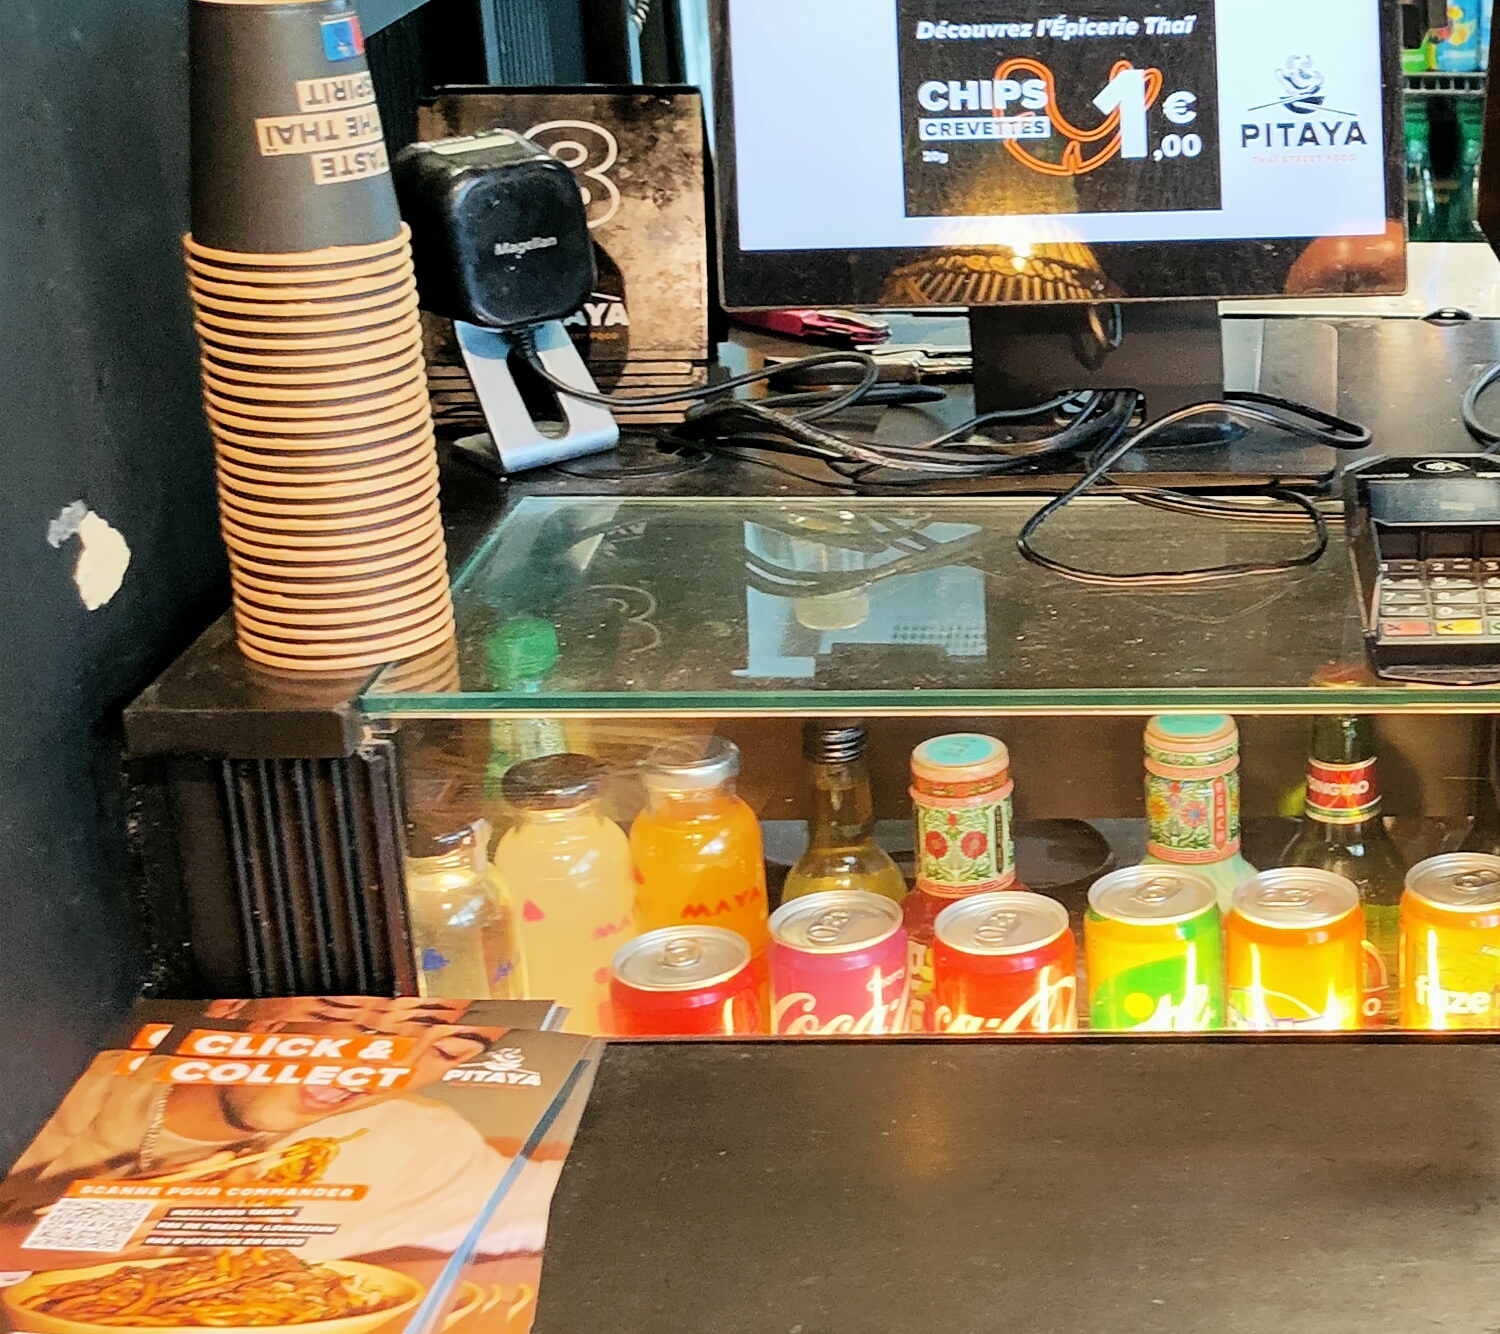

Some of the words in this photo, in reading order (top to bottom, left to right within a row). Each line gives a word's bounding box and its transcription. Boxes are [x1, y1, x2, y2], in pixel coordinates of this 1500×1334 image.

[915, 20, 1034, 40] Découvrez
[1036, 14, 1140, 41] l'Épicerie
[1143, 14, 1198, 36] Thaï
[917, 79, 1050, 112] CHIPS
[266, 118, 341, 154] THAÏ
[925, 120, 1046, 136] CREVETTES
[1241, 121, 1368, 148] PITAYA
[194, 1035, 352, 1058] CLICK
[358, 1039, 396, 1060] &
[170, 1061, 411, 1087] COLLECT
[442, 1069, 543, 1087] PITAYA
[79, 1185, 162, 1196] SCANNE
[165, 1186, 222, 1196] POUR
[225, 1186, 356, 1198] COMMANDER
